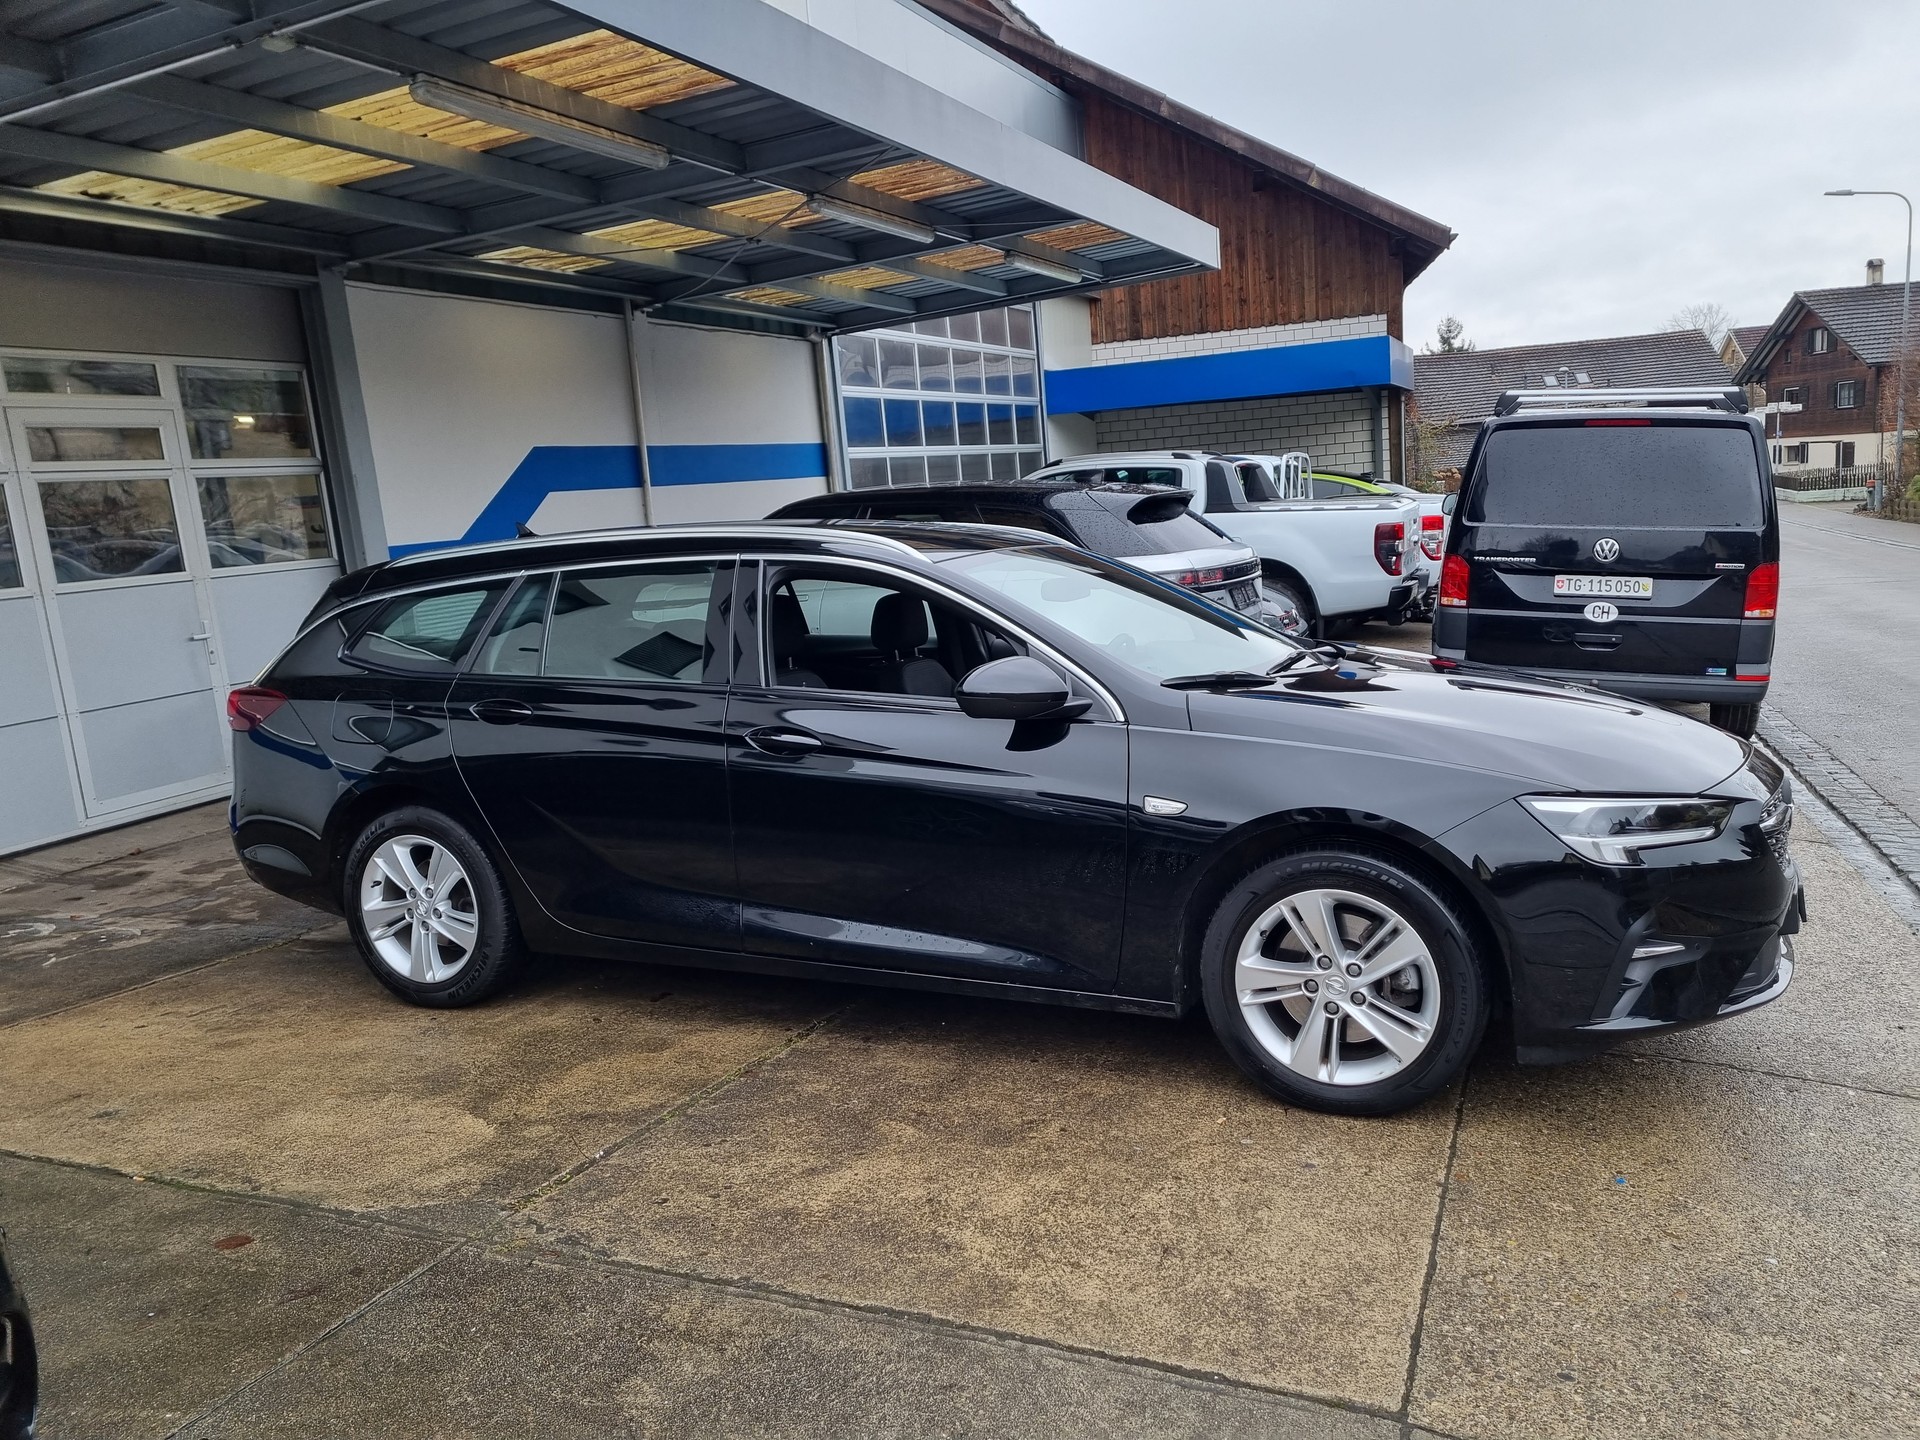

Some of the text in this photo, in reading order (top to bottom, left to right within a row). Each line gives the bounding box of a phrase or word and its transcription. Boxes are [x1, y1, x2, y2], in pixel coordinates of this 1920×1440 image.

[1594, 538, 1620, 562] VW
[1592, 605, 1611, 620] CH
[1301, 861, 1405, 889] MICHELIN
[447, 950, 489, 1000] MICHELIN
